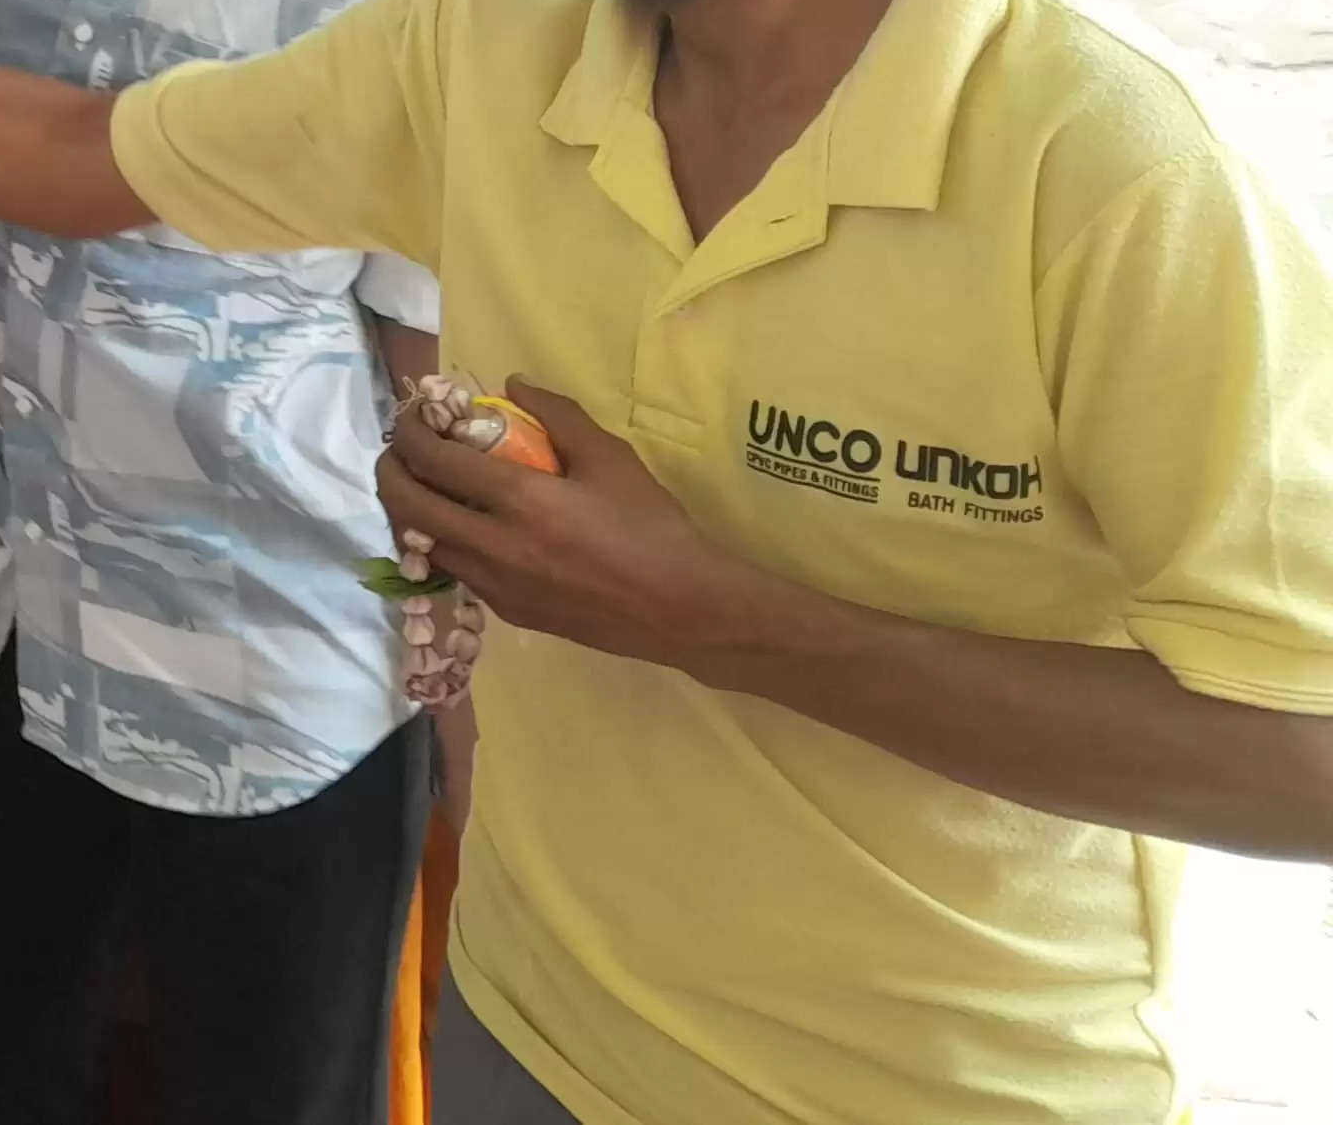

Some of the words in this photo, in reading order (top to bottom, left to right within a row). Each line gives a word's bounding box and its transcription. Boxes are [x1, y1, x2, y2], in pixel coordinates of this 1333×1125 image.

[749, 399, 882, 473] UNCO
[774, 461, 807, 480] PIPES
[811, 471, 820, 483] &
[823, 474, 879, 498] FITTINGS
[907, 491, 955, 514] BATH
[964, 502, 1044, 524] FITTINGS
